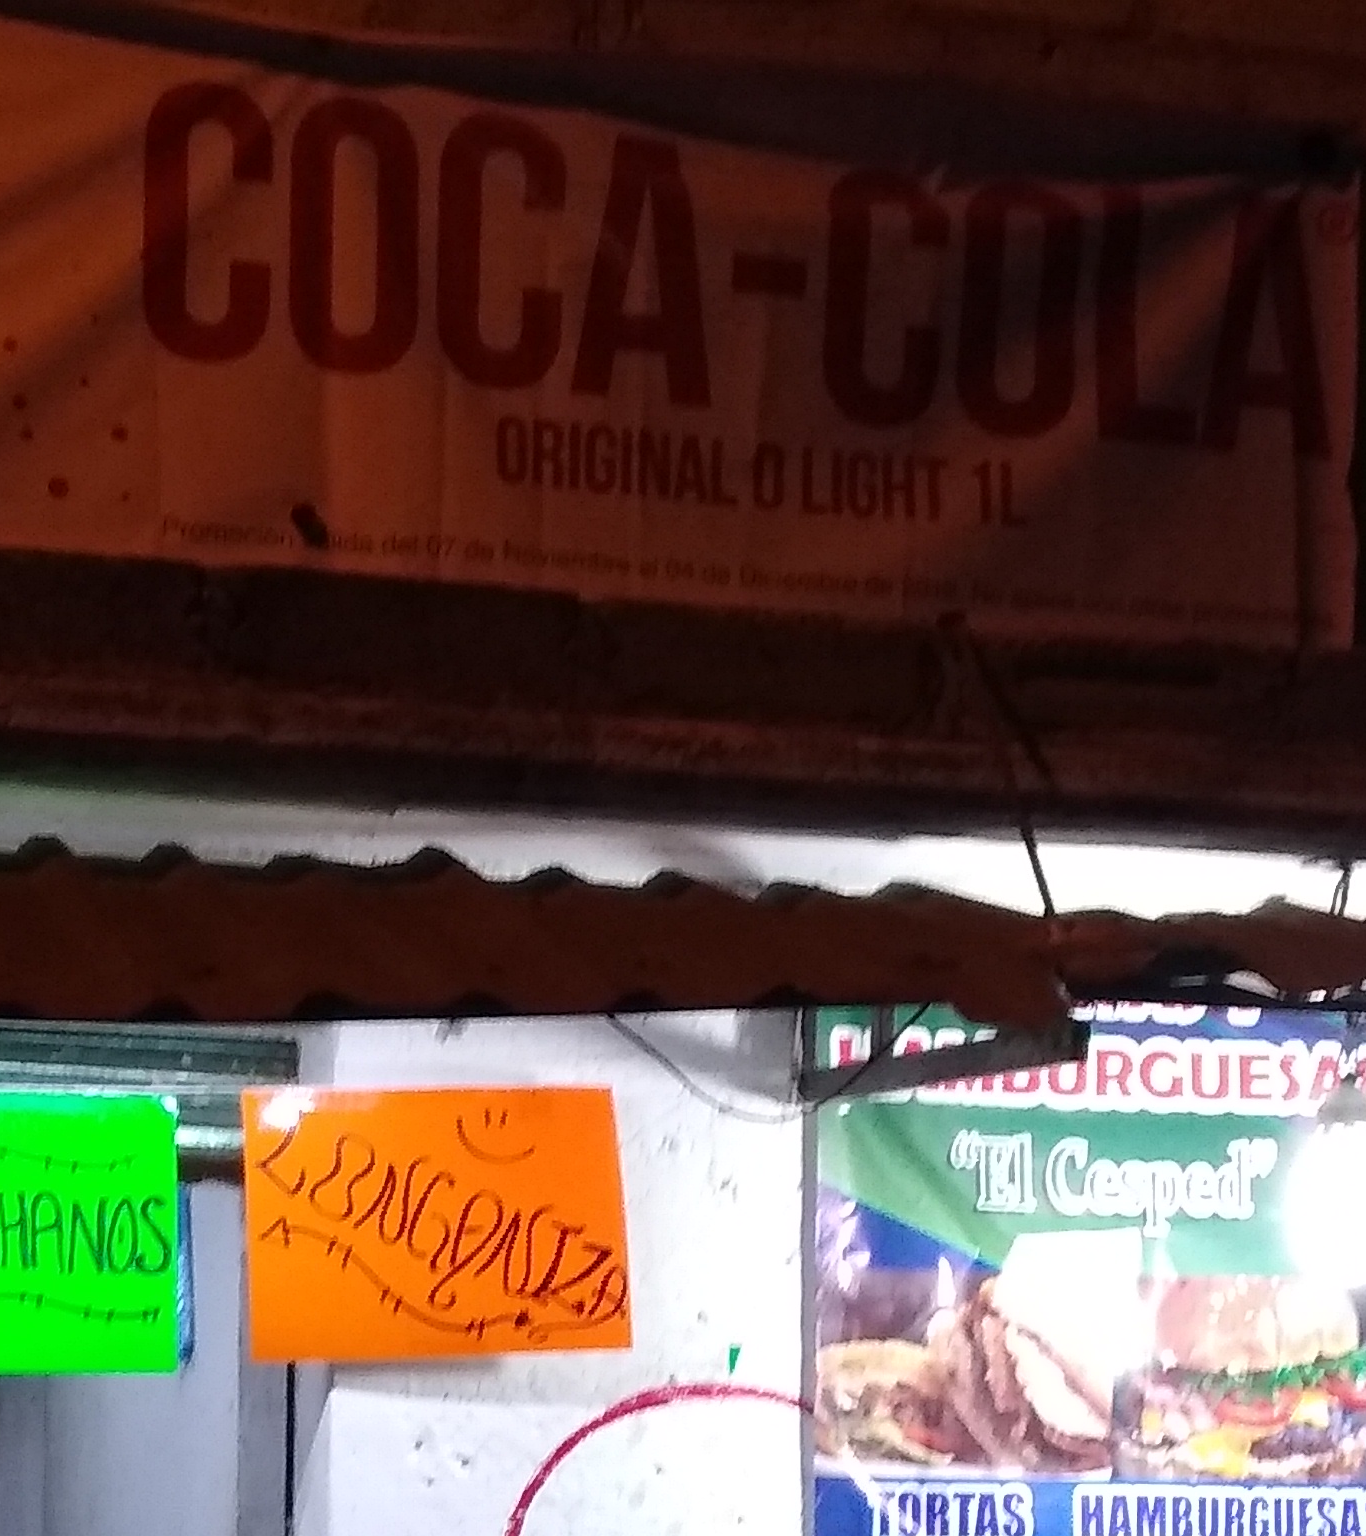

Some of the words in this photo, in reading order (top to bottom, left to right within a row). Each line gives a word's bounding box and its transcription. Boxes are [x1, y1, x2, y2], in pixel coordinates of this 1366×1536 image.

[139, 82, 1332, 462] COCA-COLA
[495, 415, 735, 506] ORIGINAL
[801, 446, 948, 523] LIGHT
[972, 459, 1028, 528] 1L
